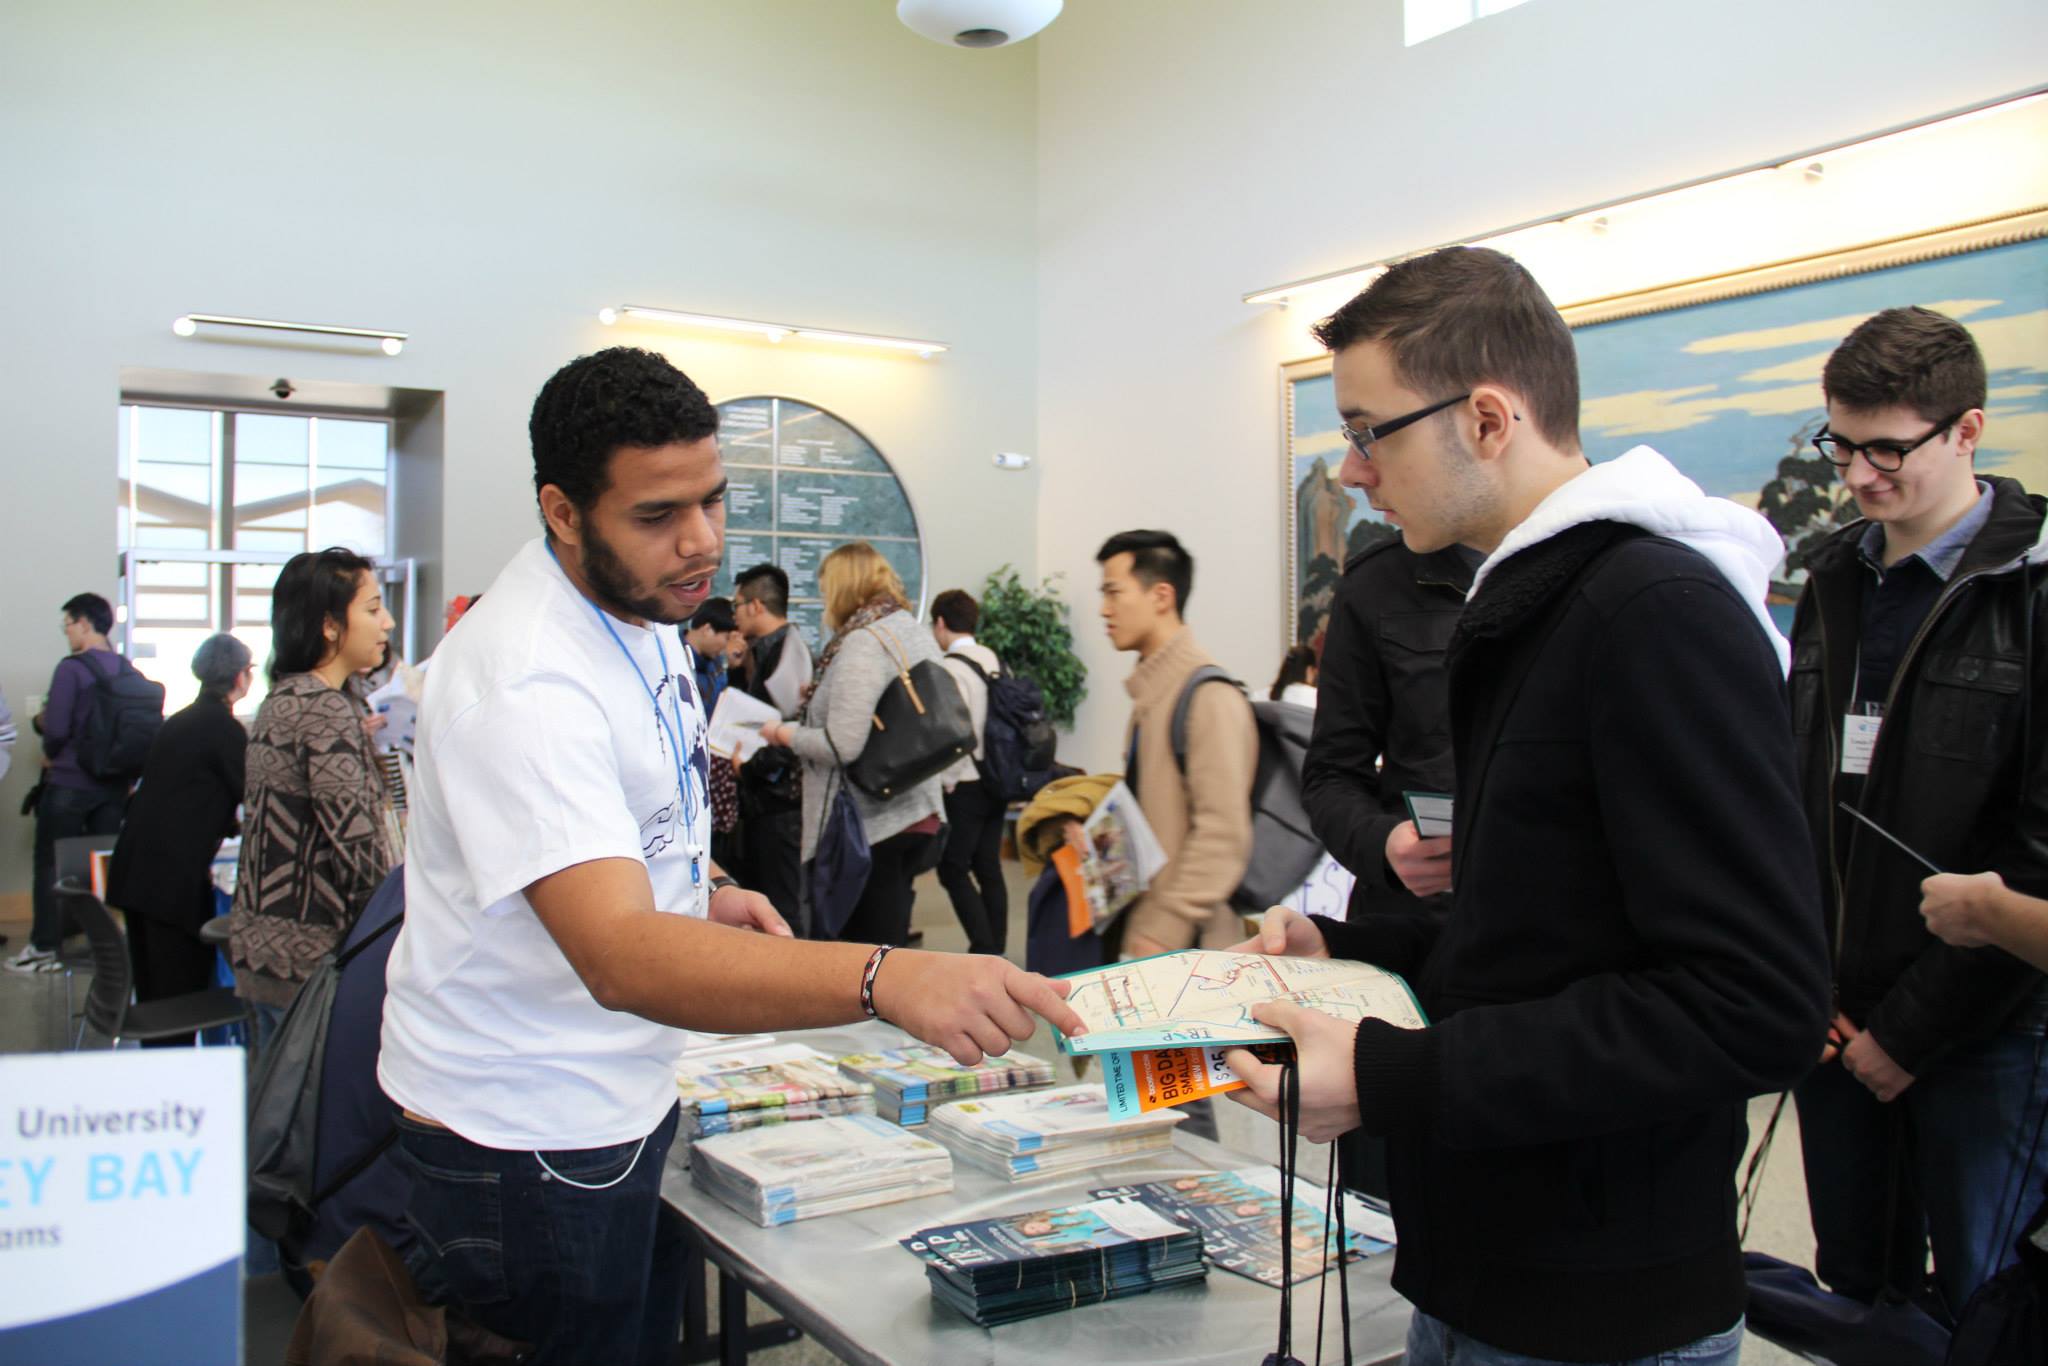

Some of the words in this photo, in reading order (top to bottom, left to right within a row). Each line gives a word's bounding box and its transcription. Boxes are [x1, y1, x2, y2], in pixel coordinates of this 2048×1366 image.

[1112, 1065, 1123, 1083] TIME
[1154, 1048, 1174, 1072] DA
[1159, 1072, 1179, 1101] BIG
[1178, 1058, 1194, 1095] SMALL
[1116, 1082, 1128, 1113] LIMITED
[17, 1101, 205, 1138] University
[87, 1149, 204, 1202] BAY
